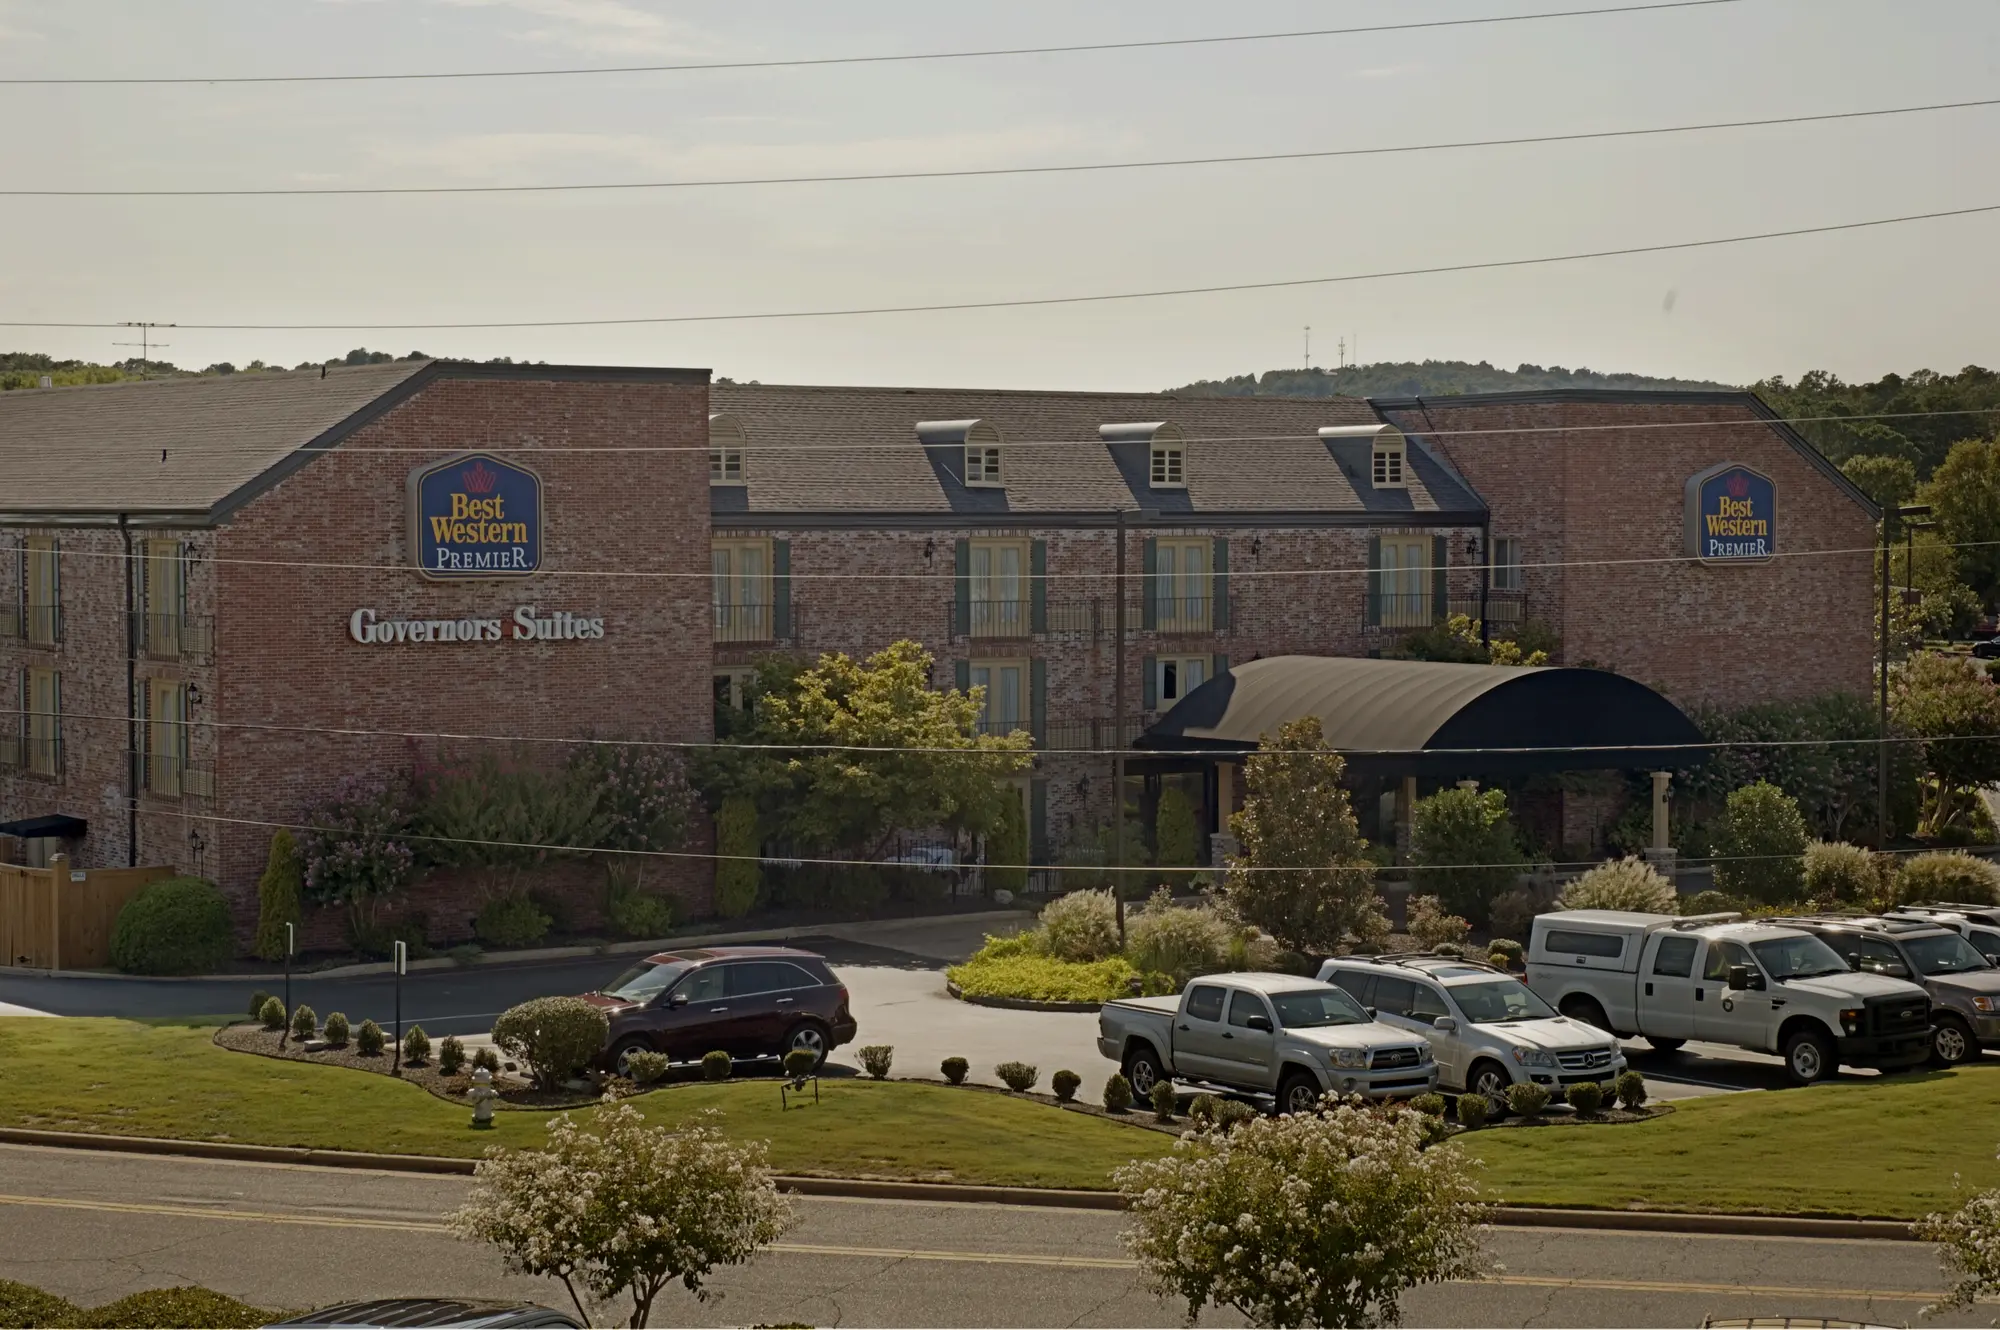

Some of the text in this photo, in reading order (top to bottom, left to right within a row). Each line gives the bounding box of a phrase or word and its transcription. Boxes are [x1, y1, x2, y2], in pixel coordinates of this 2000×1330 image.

[449, 492, 505, 520] Best
[1719, 496, 1754, 518] Best
[429, 516, 529, 544] Western
[1705, 514, 1768, 537] Western
[436, 546, 528, 569] PREMIER
[1709, 538, 1767, 556] PREMIER
[350, 605, 605, 643] Governors Suites
